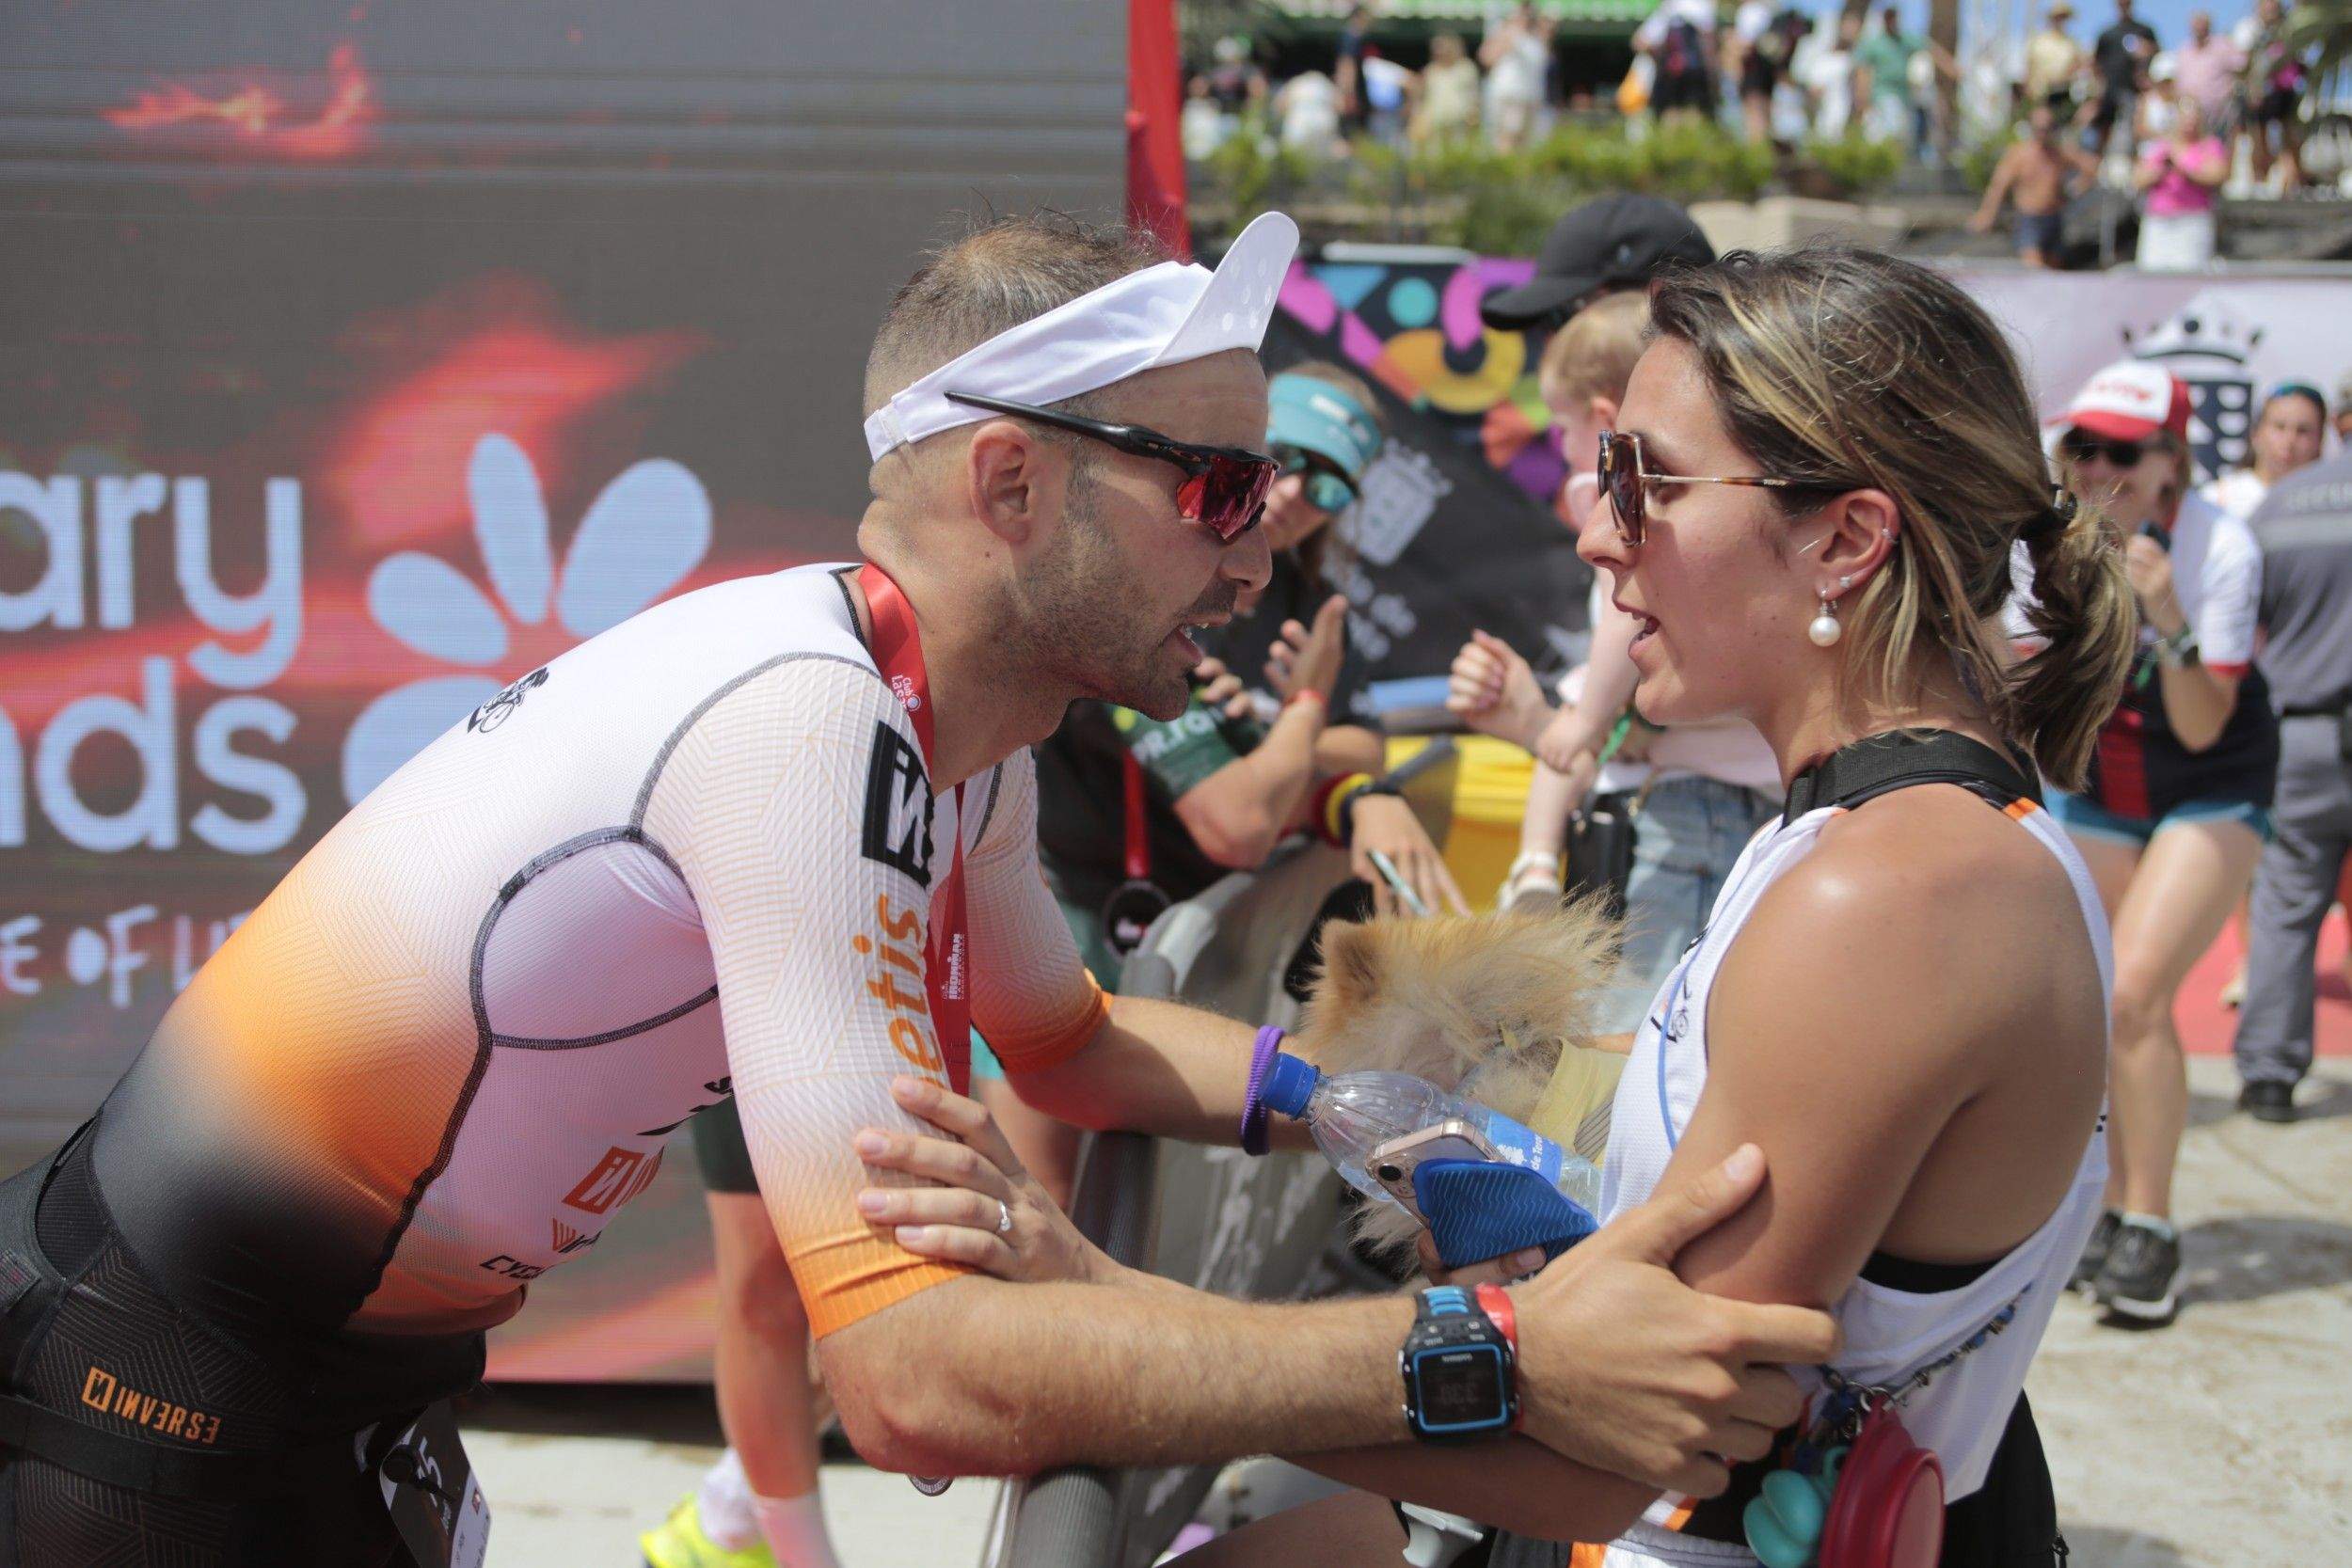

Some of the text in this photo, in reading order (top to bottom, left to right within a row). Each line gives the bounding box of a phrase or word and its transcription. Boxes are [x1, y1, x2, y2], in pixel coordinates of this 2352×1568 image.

[0, 654, 308, 855] ds
[65, 904, 158, 1009] OF
[172, 909, 252, 994] LI
[852, 893, 945, 1089] etis
[947, 933, 961, 1000] IRONMAN
[113, 1386, 222, 1445] INVERSE
